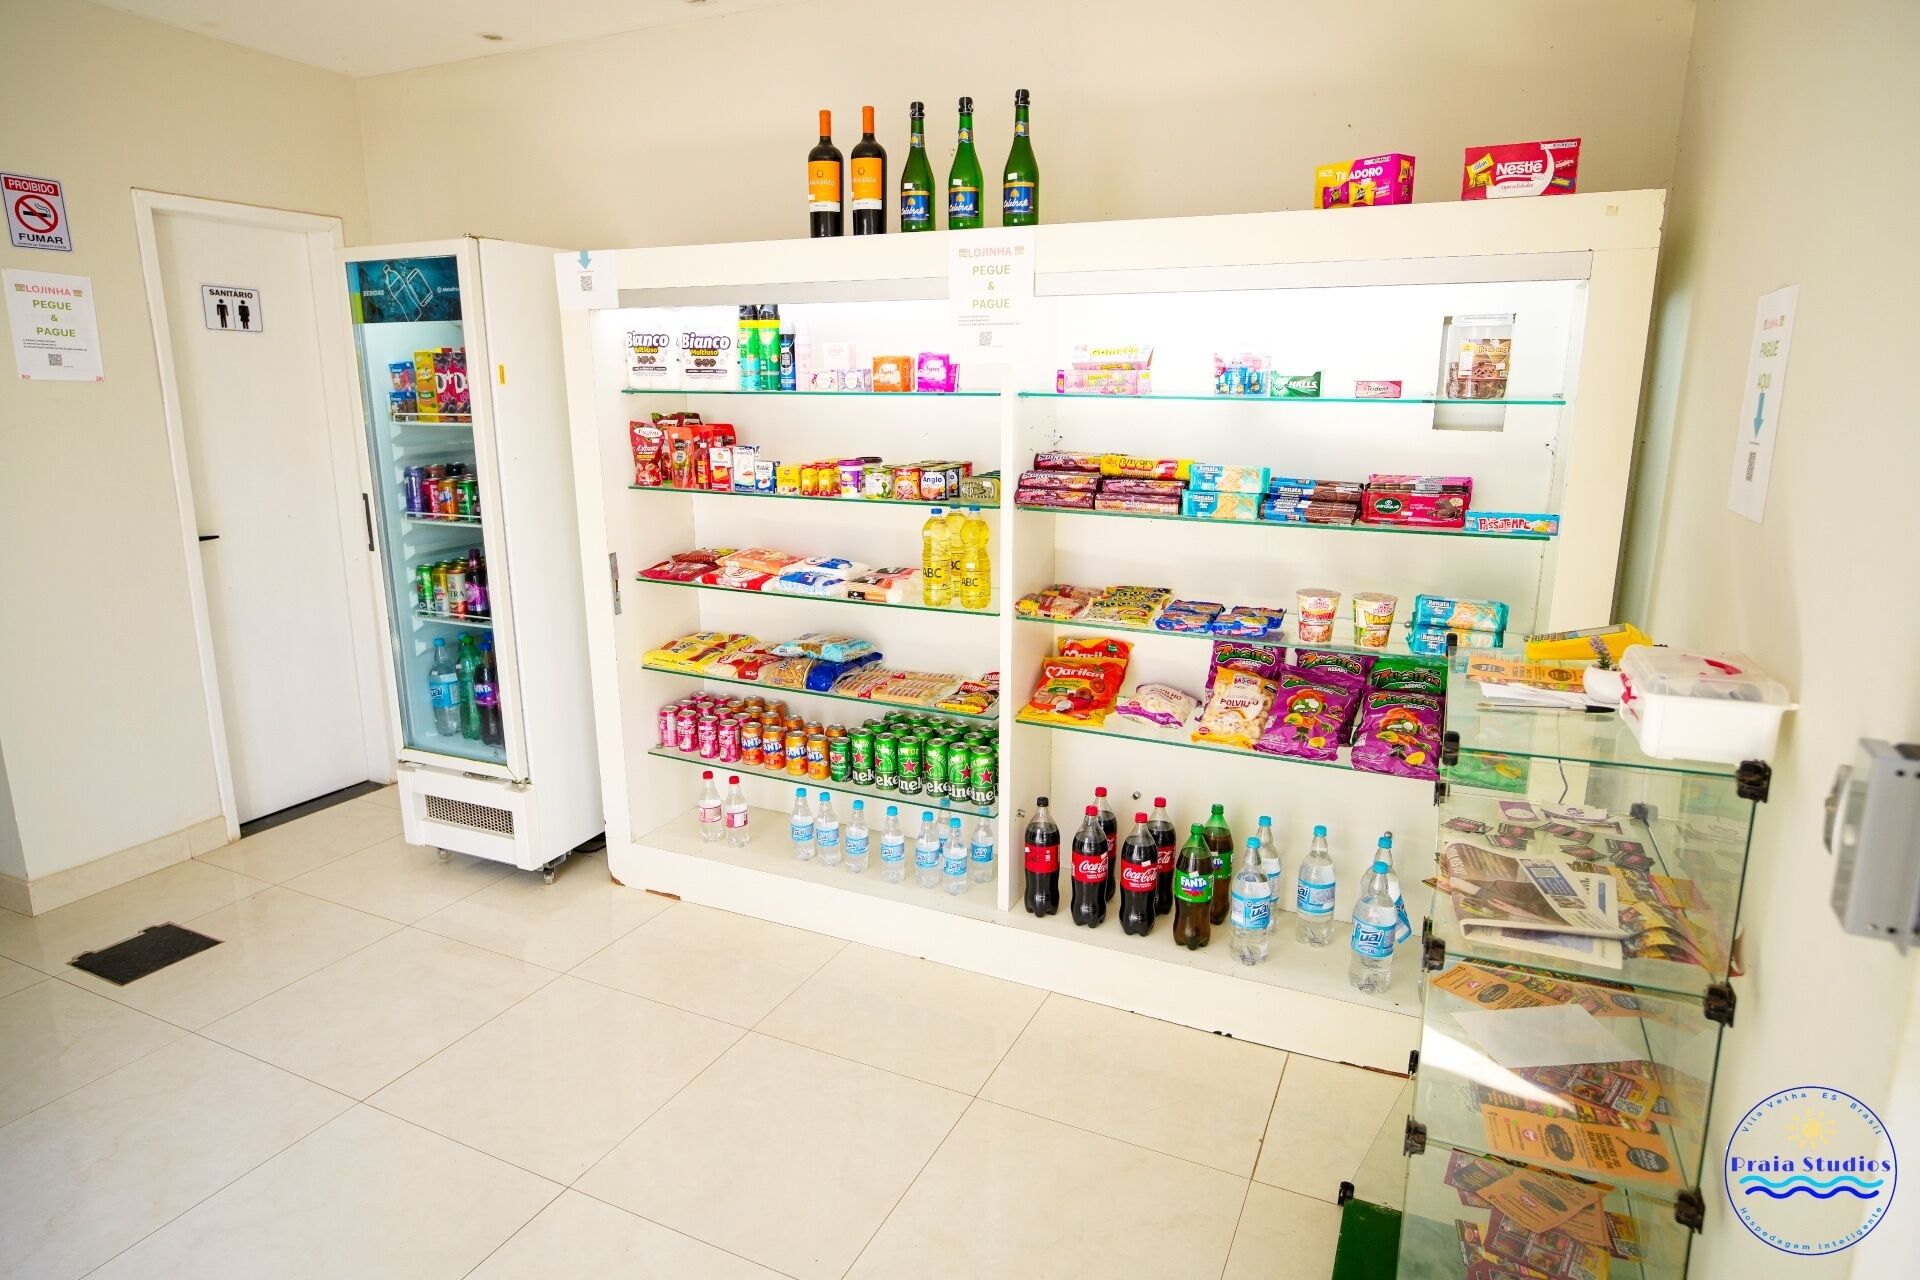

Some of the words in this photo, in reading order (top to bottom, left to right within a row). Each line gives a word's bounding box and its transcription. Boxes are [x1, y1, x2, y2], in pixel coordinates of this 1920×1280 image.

[1349, 166, 1384, 180] ADORO
[1496, 160, 1543, 175] Nestlé
[7, 179, 55, 195] PROIBIDO
[18, 232, 64, 244] FUMAR
[968, 247, 1012, 258] LOJINHA
[972, 265, 1011, 276] PEGUE
[25, 284, 72, 297] LOJINHA
[988, 281, 995, 290] &
[209, 288, 253, 300] SANITÁRIO
[32, 299, 72, 311] PEGUE
[972, 299, 1011, 309] PAGUE
[50, 314, 59, 322] &
[36, 326, 76, 338] PAGUE
[682, 332, 731, 350] Bianco
[634, 346, 659, 354] ultiuso
[1289, 380, 1318, 389] HALLS
[1366, 385, 1390, 393] Trident
[922, 477, 943, 485] Anglo
[950, 561, 960, 571] BC
[923, 567, 942, 578] ABC
[961, 578, 979, 587] ABC
[1422, 634, 1444, 642] Renata
[1046, 666, 1105, 680] Marilan
[1312, 687, 1334, 695] ASSADO
[807, 751, 824, 761] ANTA
[1180, 875, 1207, 888] FANTA
[1360, 930, 1384, 944] uai
